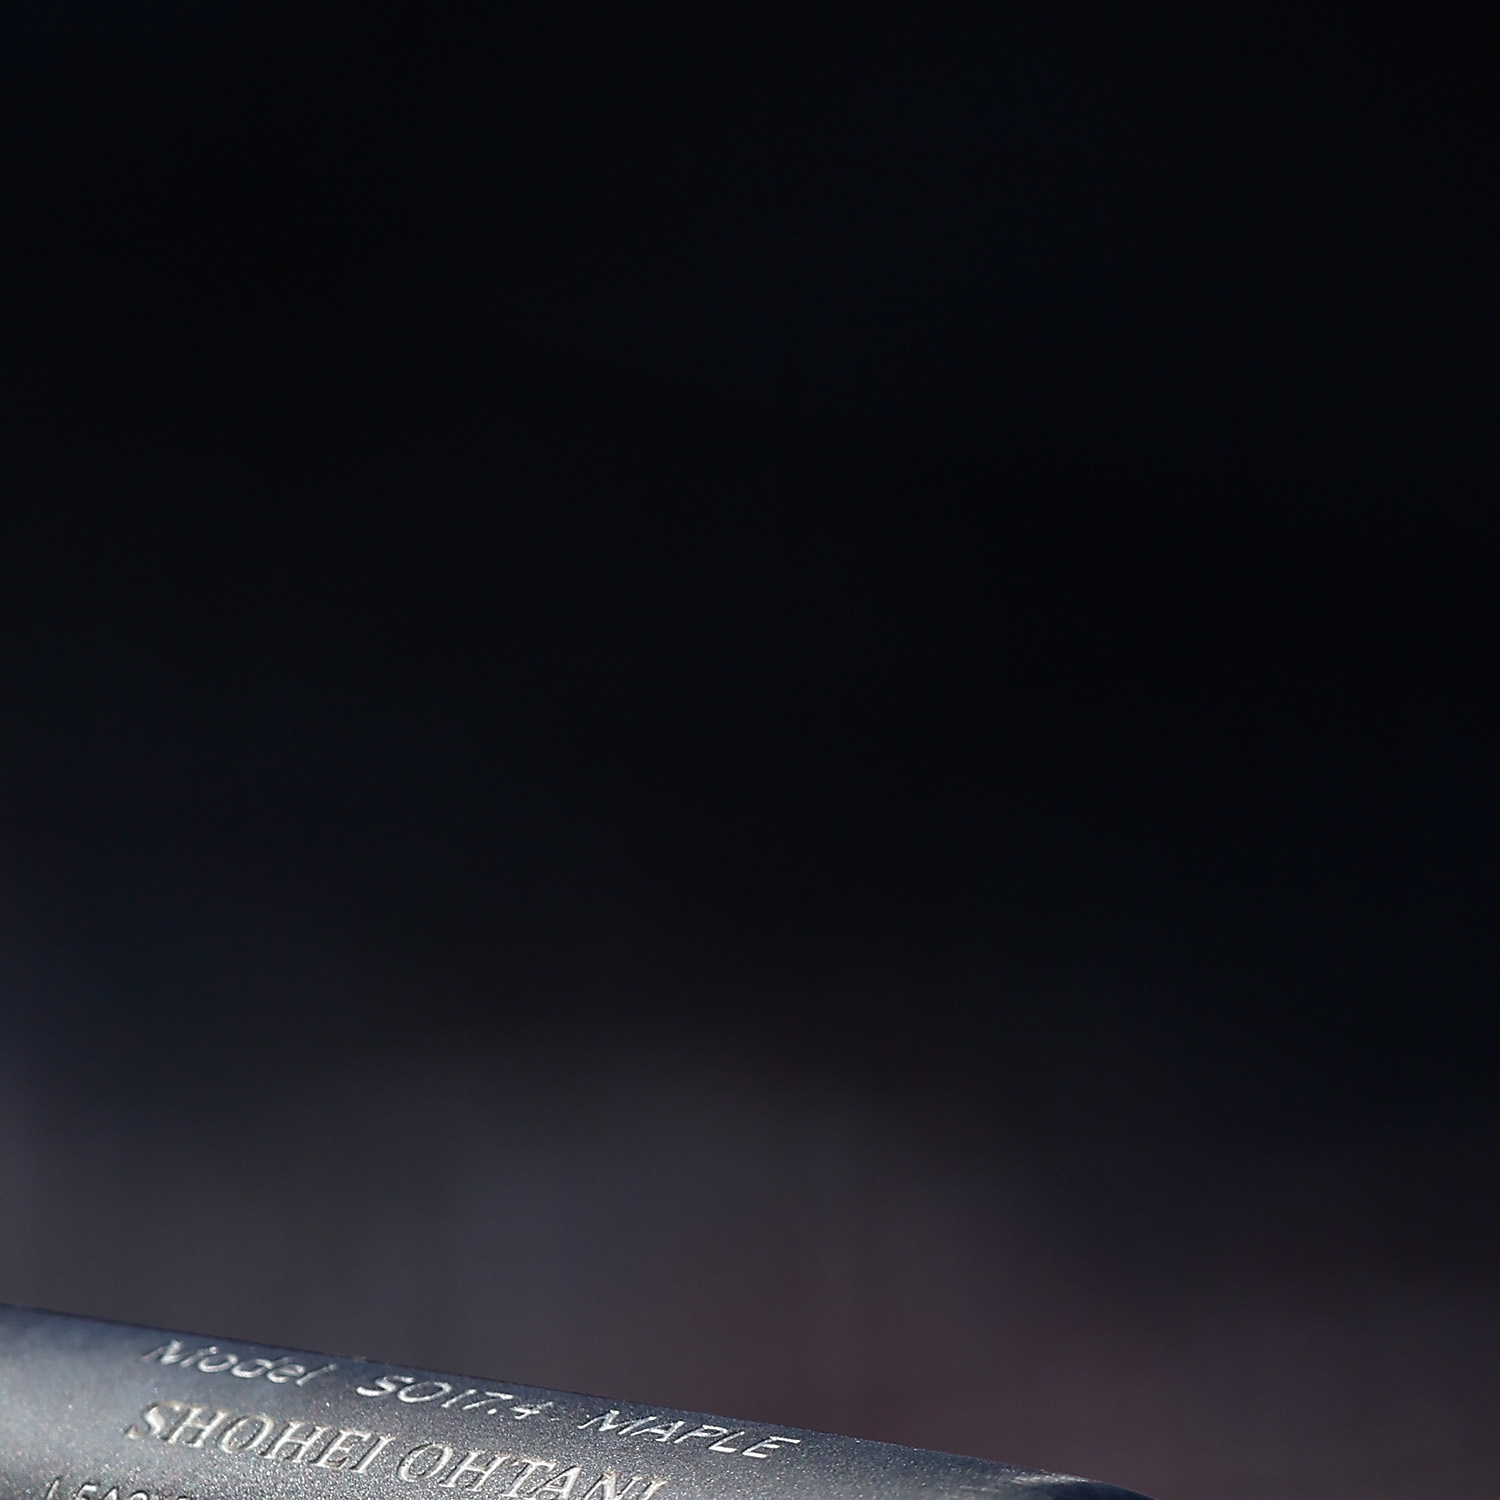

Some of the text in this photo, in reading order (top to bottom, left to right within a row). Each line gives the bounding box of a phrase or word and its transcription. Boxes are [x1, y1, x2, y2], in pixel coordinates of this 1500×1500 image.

[125, 1400, 394, 1474] SHOHEI
[142, 1339, 337, 1386] Model
[578, 1410, 800, 1459] MAPLE
